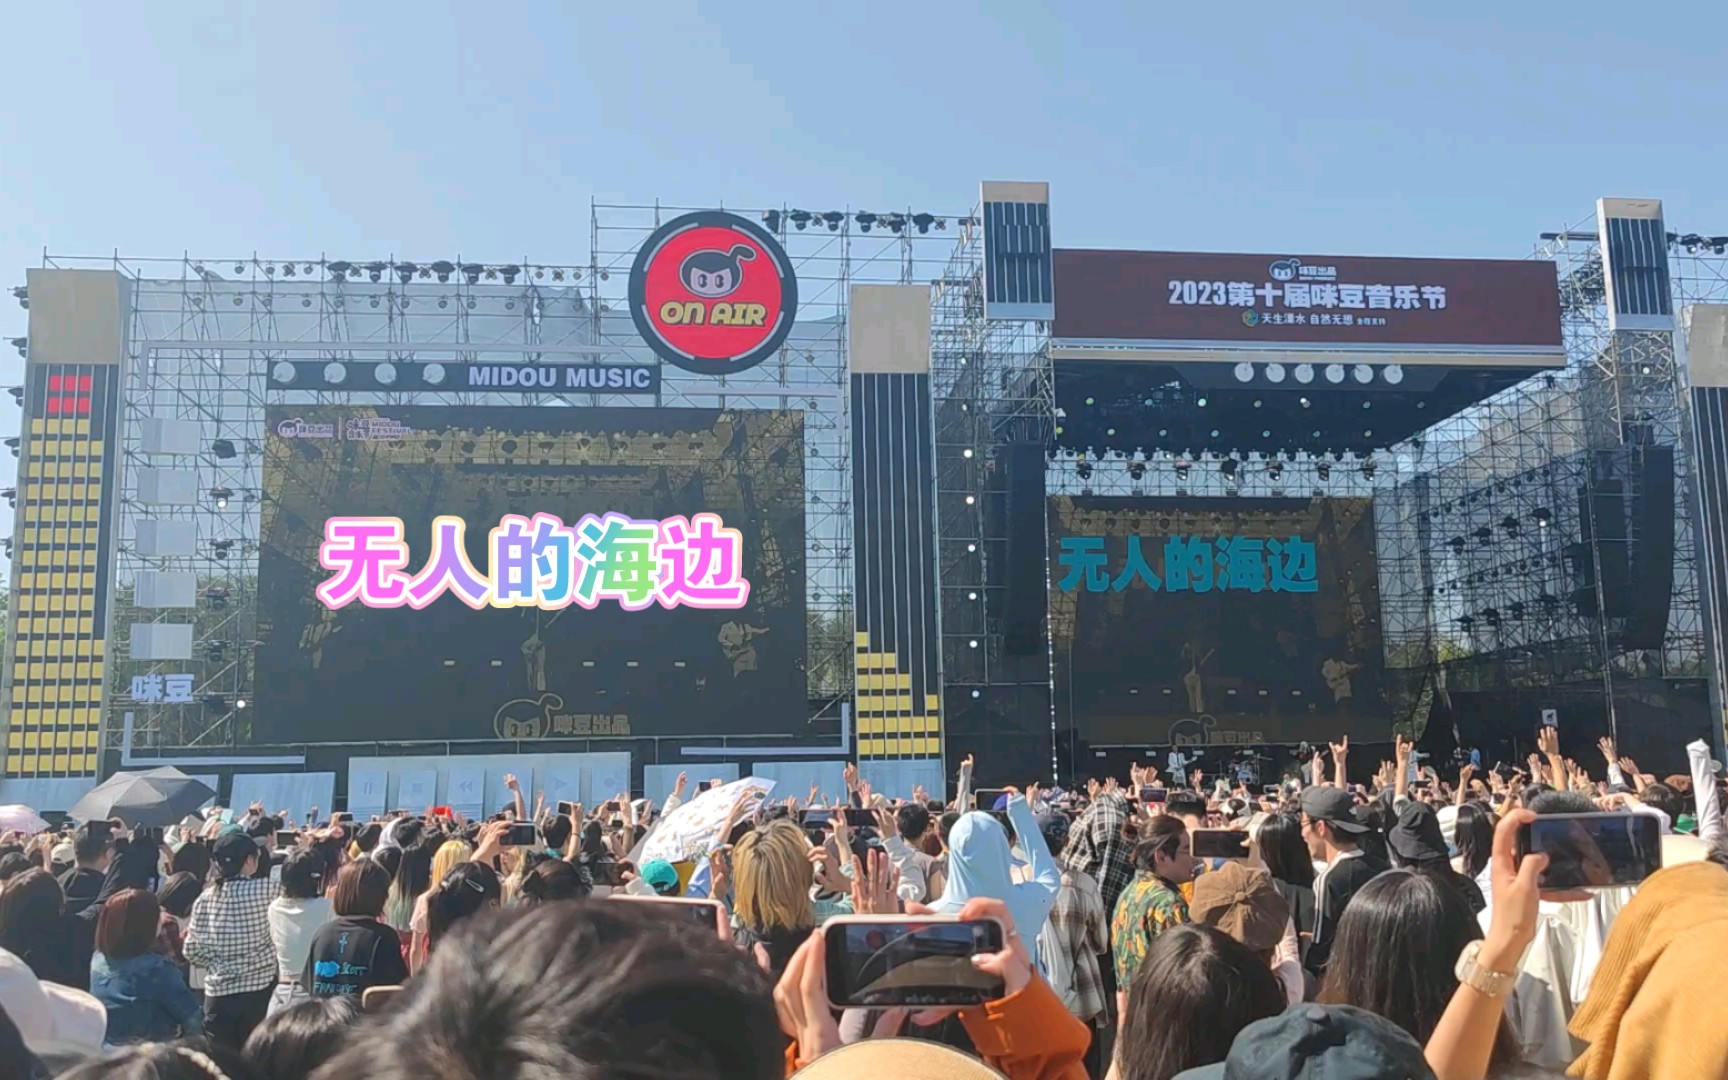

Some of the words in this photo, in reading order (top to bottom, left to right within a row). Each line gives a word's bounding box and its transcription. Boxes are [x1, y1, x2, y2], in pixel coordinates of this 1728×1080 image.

[710, 302, 766, 327] AIR
[469, 366, 557, 387] MIDOU
[566, 368, 651, 388] MUSIC
[1057, 535, 1319, 592] 无人的海边
